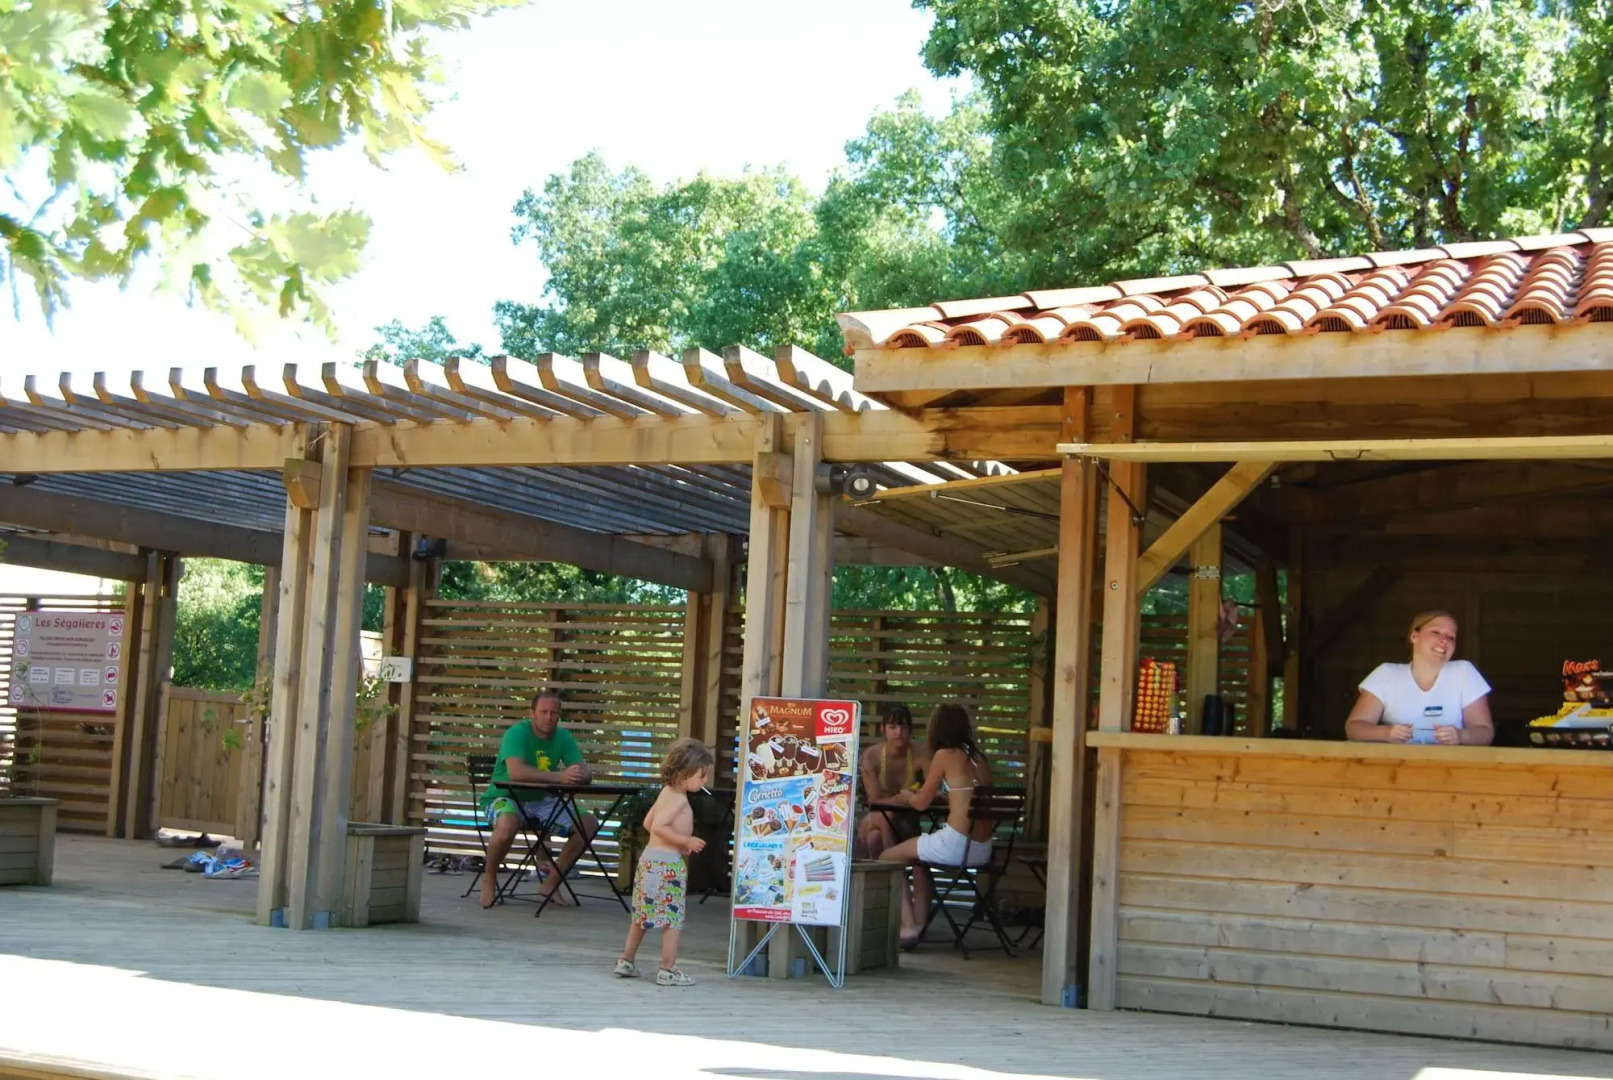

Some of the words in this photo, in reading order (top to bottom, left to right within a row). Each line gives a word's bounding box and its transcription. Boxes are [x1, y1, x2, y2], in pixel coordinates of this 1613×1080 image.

[36, 618, 51, 628] Les
[1562, 660, 1599, 676] Mars
[770, 705, 812, 716] MAGNUM
[823, 726, 845, 734] MIKO
[747, 787, 783, 804] Cornetto
[820, 781, 849, 797] Solero
